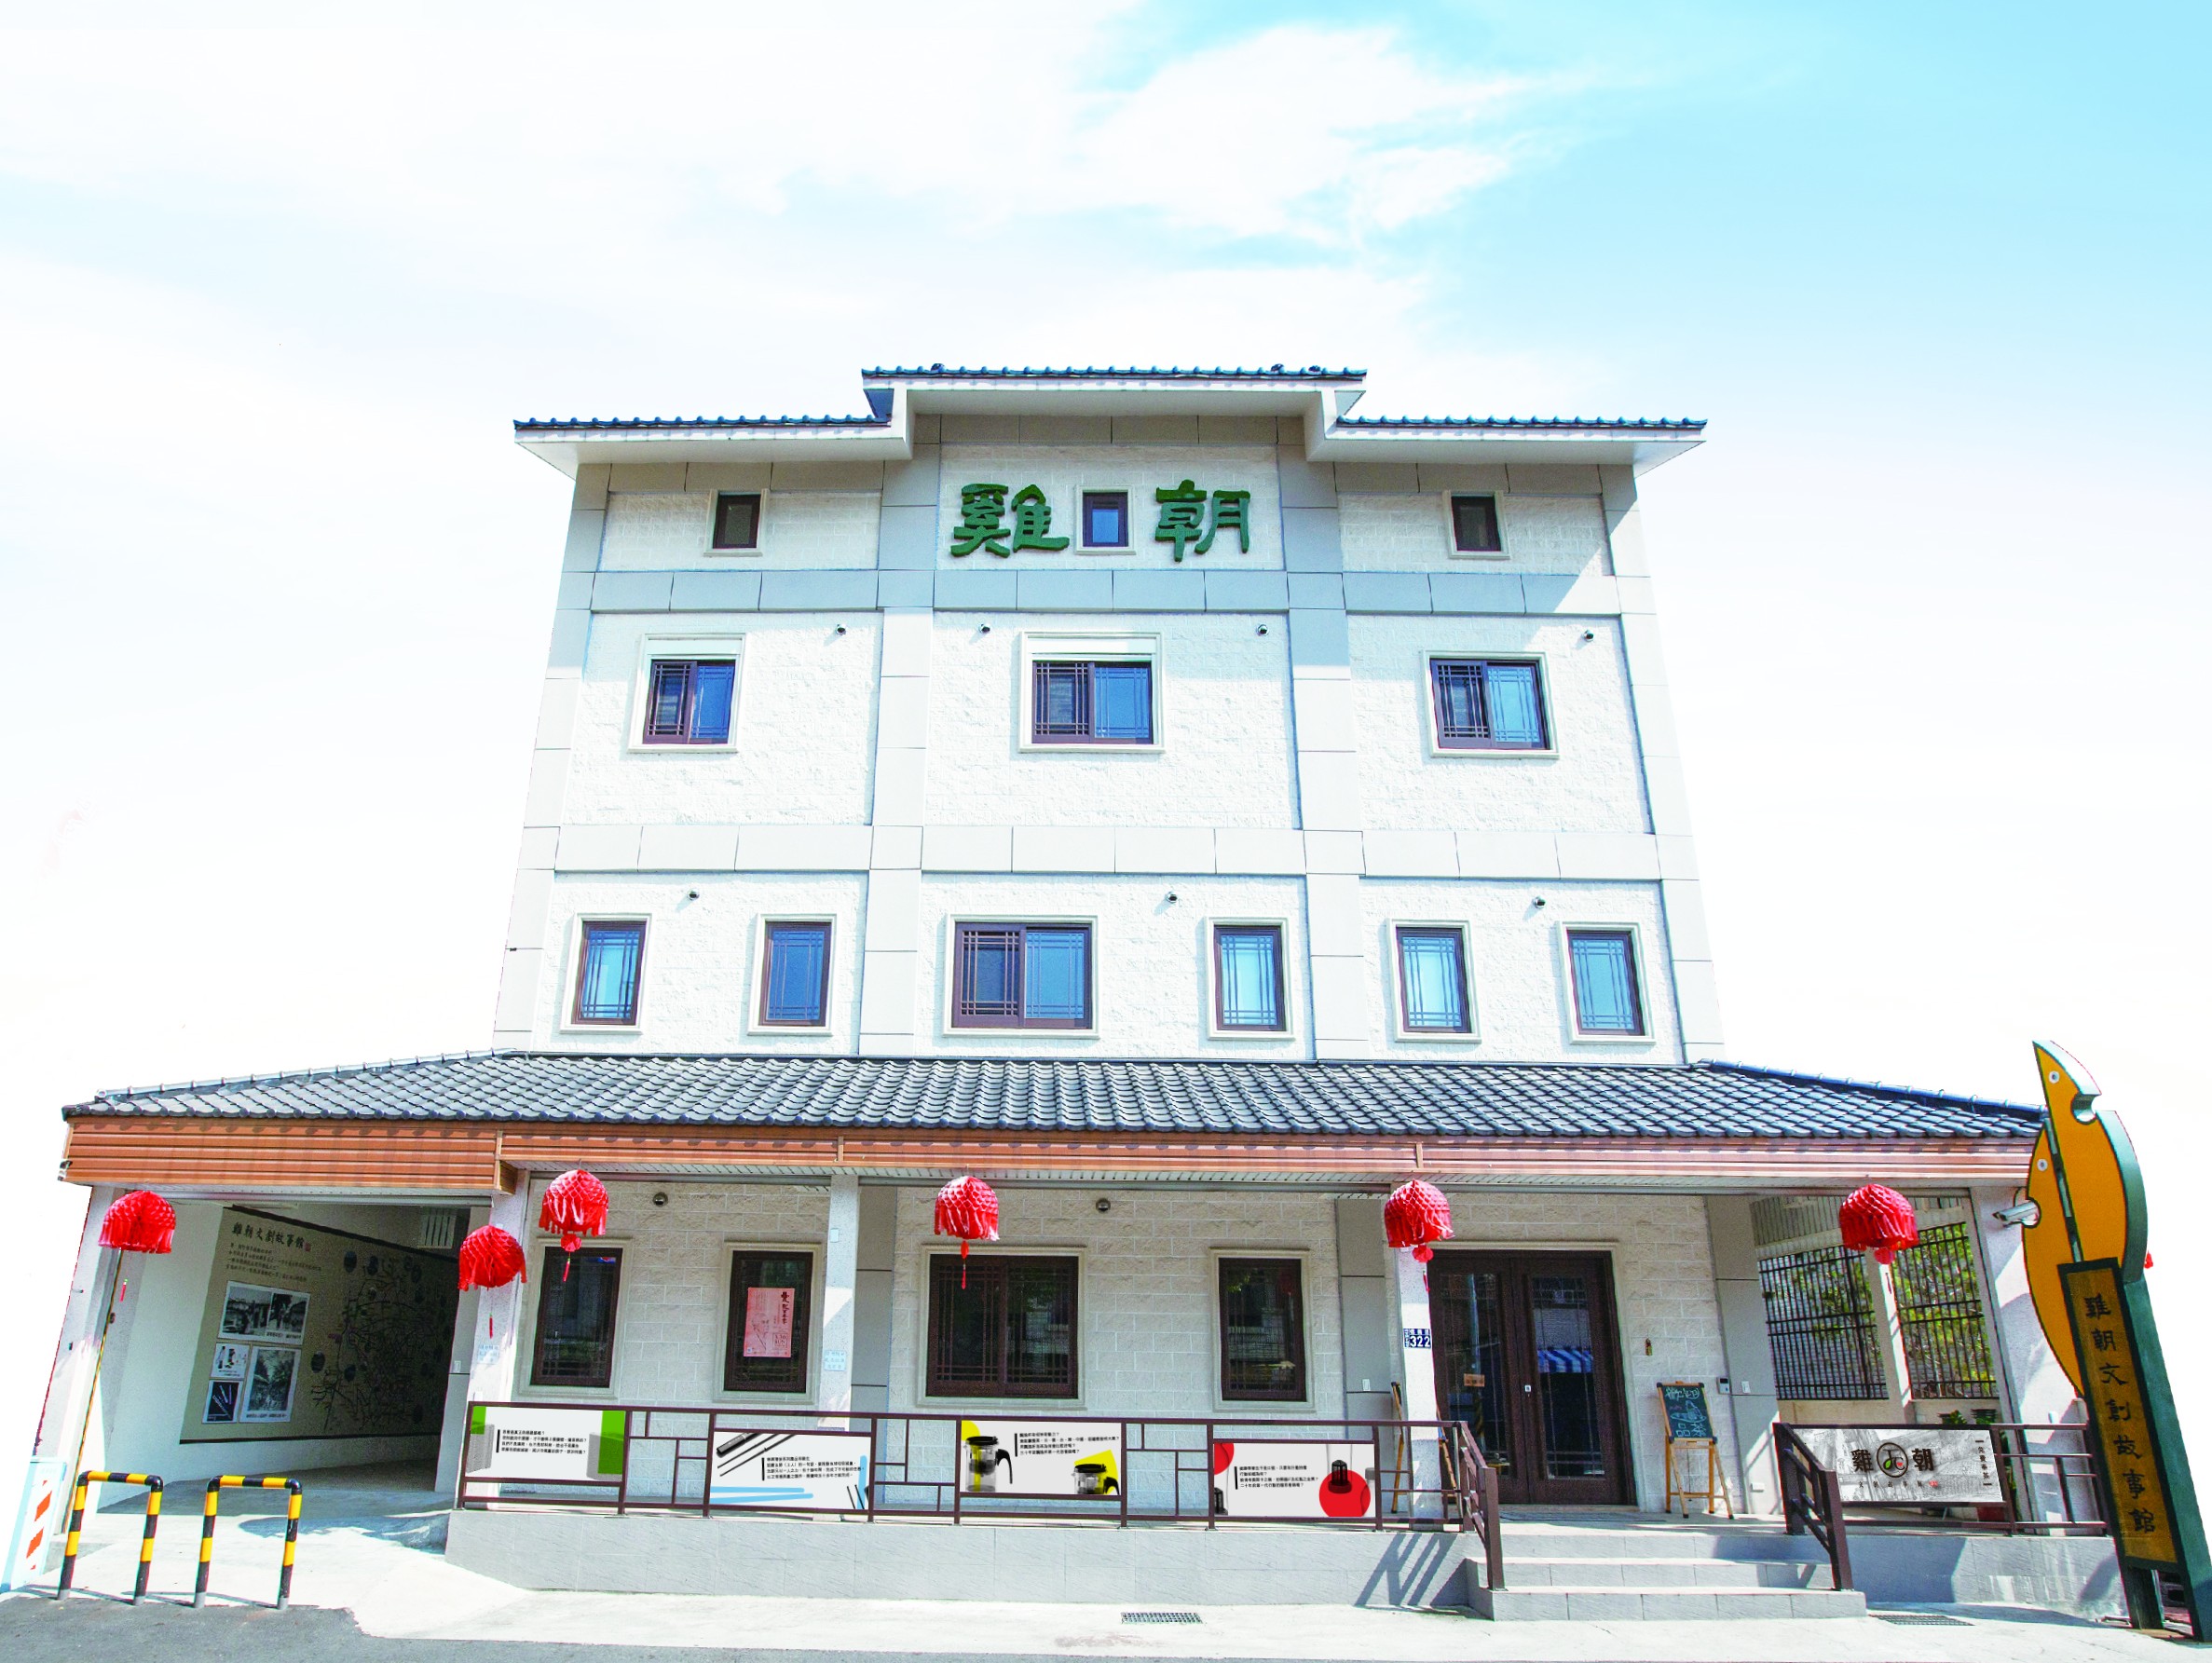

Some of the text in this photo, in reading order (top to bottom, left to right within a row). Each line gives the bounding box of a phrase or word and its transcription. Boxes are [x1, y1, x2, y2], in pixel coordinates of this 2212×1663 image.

[950, 479, 1251, 562] 雞朝
[1410, 1335, 1430, 1347] 322
[2084, 1292, 2156, 1534] 雞朝文創故事館
